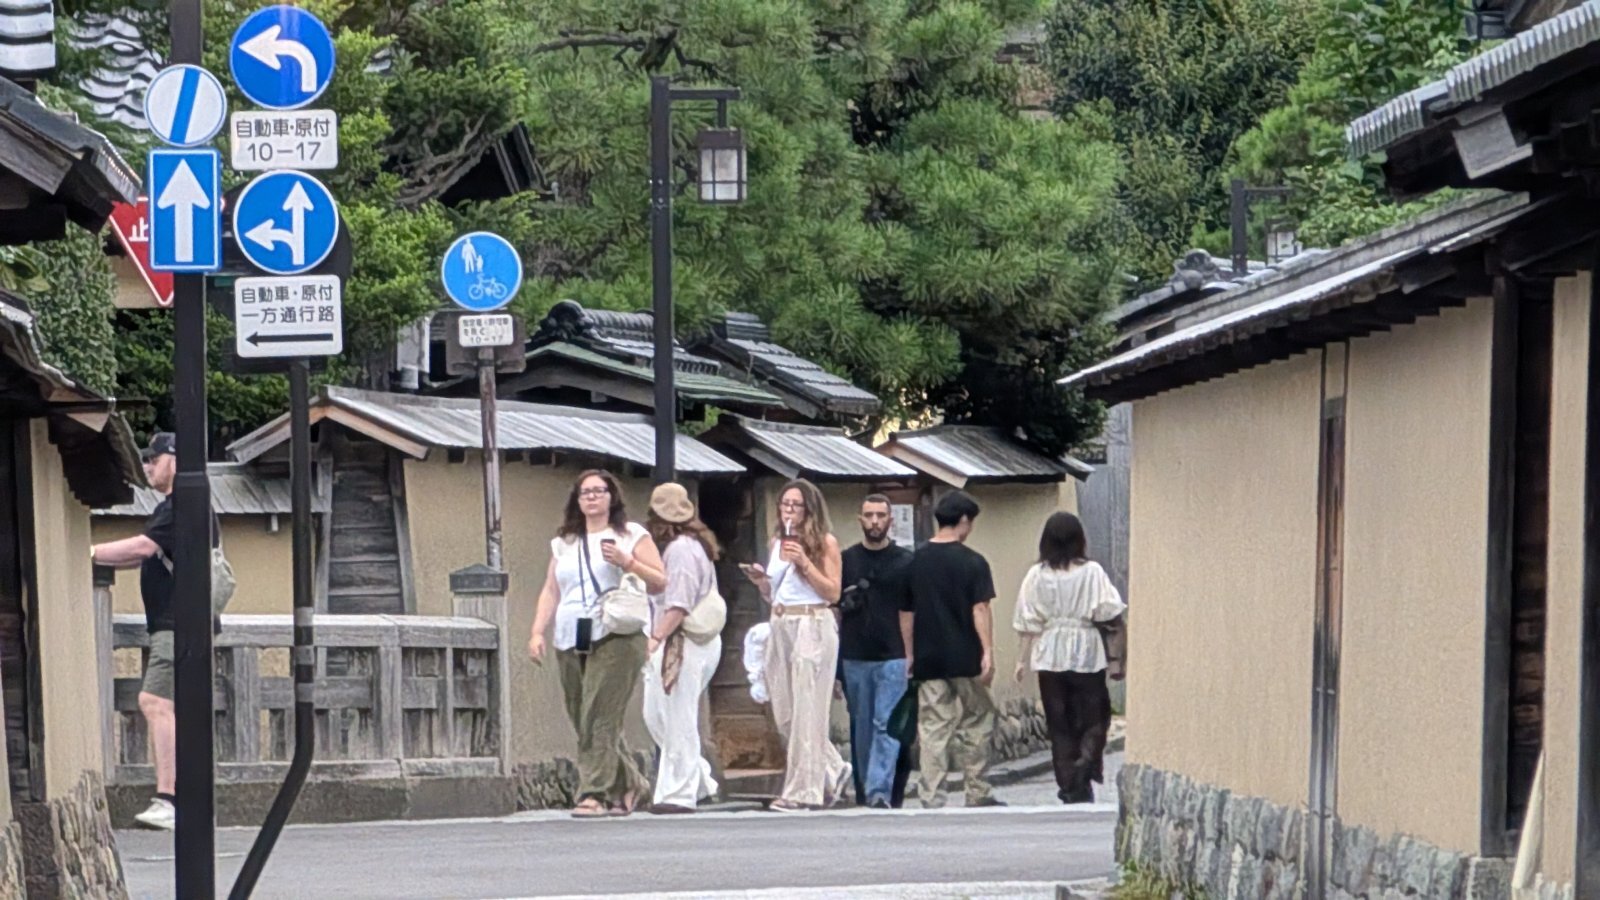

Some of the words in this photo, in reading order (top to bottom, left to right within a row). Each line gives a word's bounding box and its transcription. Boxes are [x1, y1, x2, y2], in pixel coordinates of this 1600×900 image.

[236, 118, 330, 138] 自動車・原付
[241, 284, 333, 304] 自動車・原付
[241, 305, 334, 324] 一方通行路
